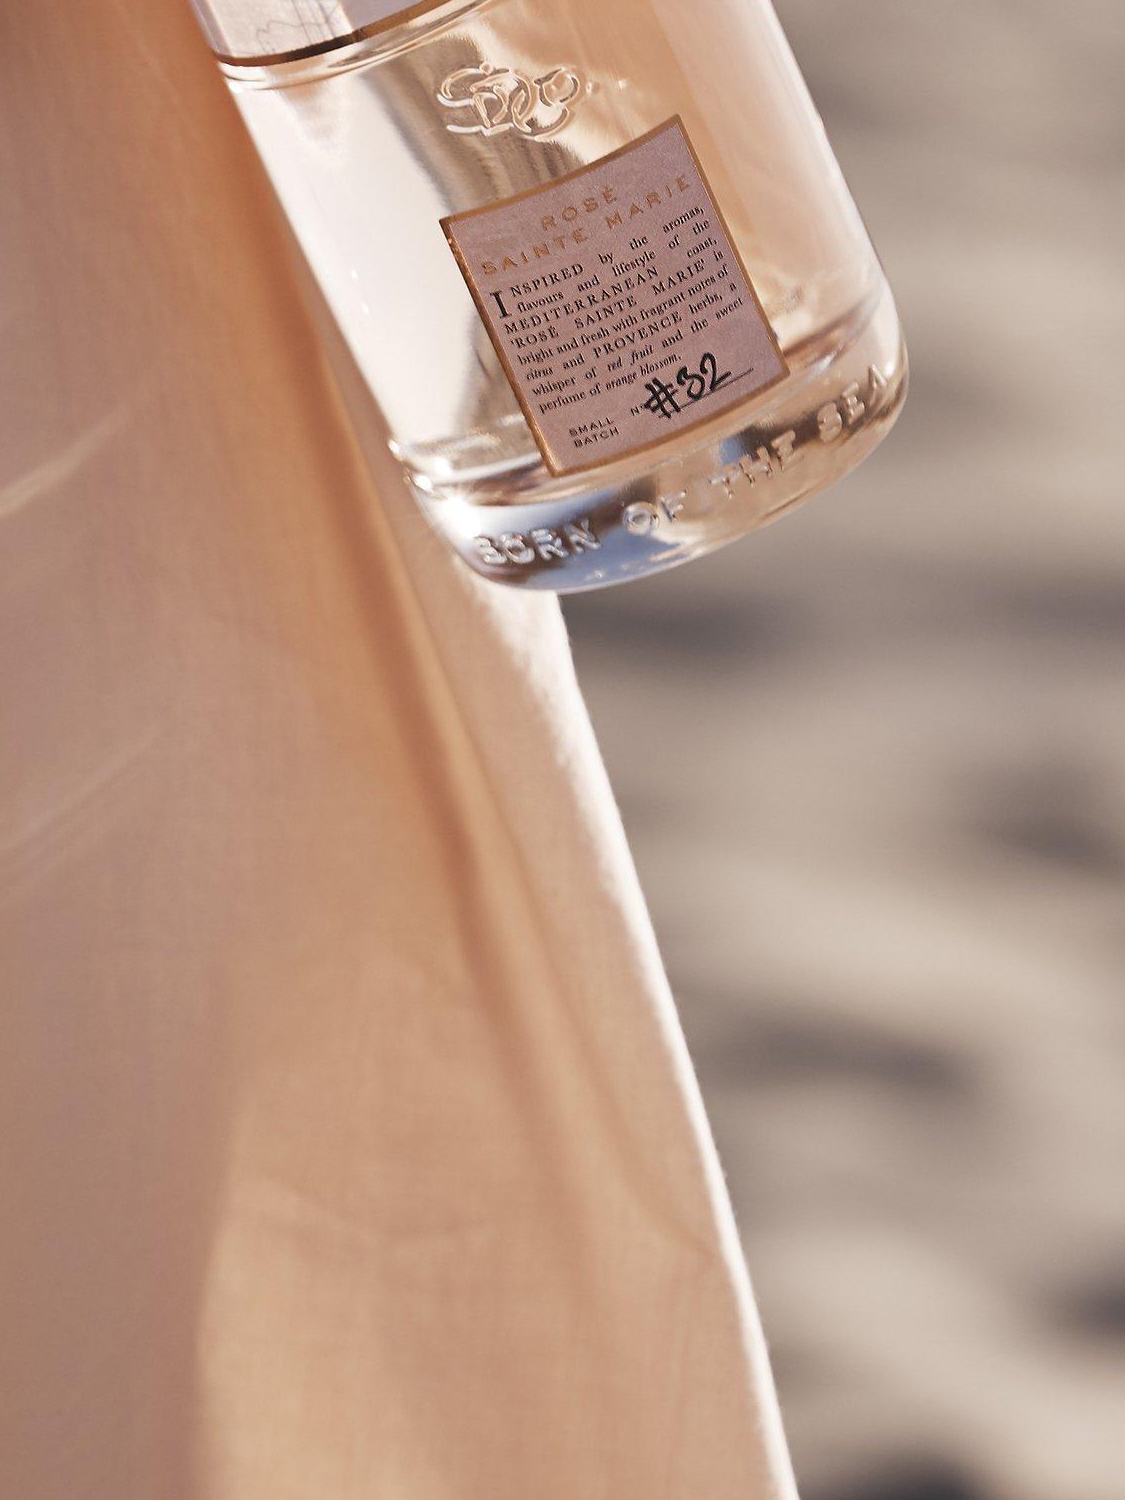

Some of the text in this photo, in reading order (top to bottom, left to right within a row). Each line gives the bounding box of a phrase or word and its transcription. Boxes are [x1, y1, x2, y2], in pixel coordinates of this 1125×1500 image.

[481, 174, 690, 276] SAINTE MARIE
[517, 219, 710, 313] flavours and lifestyle of the
[598, 252, 613, 265] by
[629, 235, 649, 251] the
[662, 205, 704, 234] aromas,
[504, 237, 717, 334] MEDITERRANEAN coast,
[517, 264, 729, 366] bright and fresh with fragrant notes of
[526, 283, 737, 381] citrus and PROVENCE herbs, a
[574, 295, 638, 329] SAINTE
[714, 251, 724, 261] is
[532, 298, 743, 396] whisper of red fruit and the sweet
[539, 390, 587, 414] perfume
[589, 382, 601, 396] of
[605, 371, 637, 391] orange
[476, 363, 889, 565] BORN OF THE SEA
[569, 416, 615, 438] SMALL
[573, 426, 620, 449] BATCH
